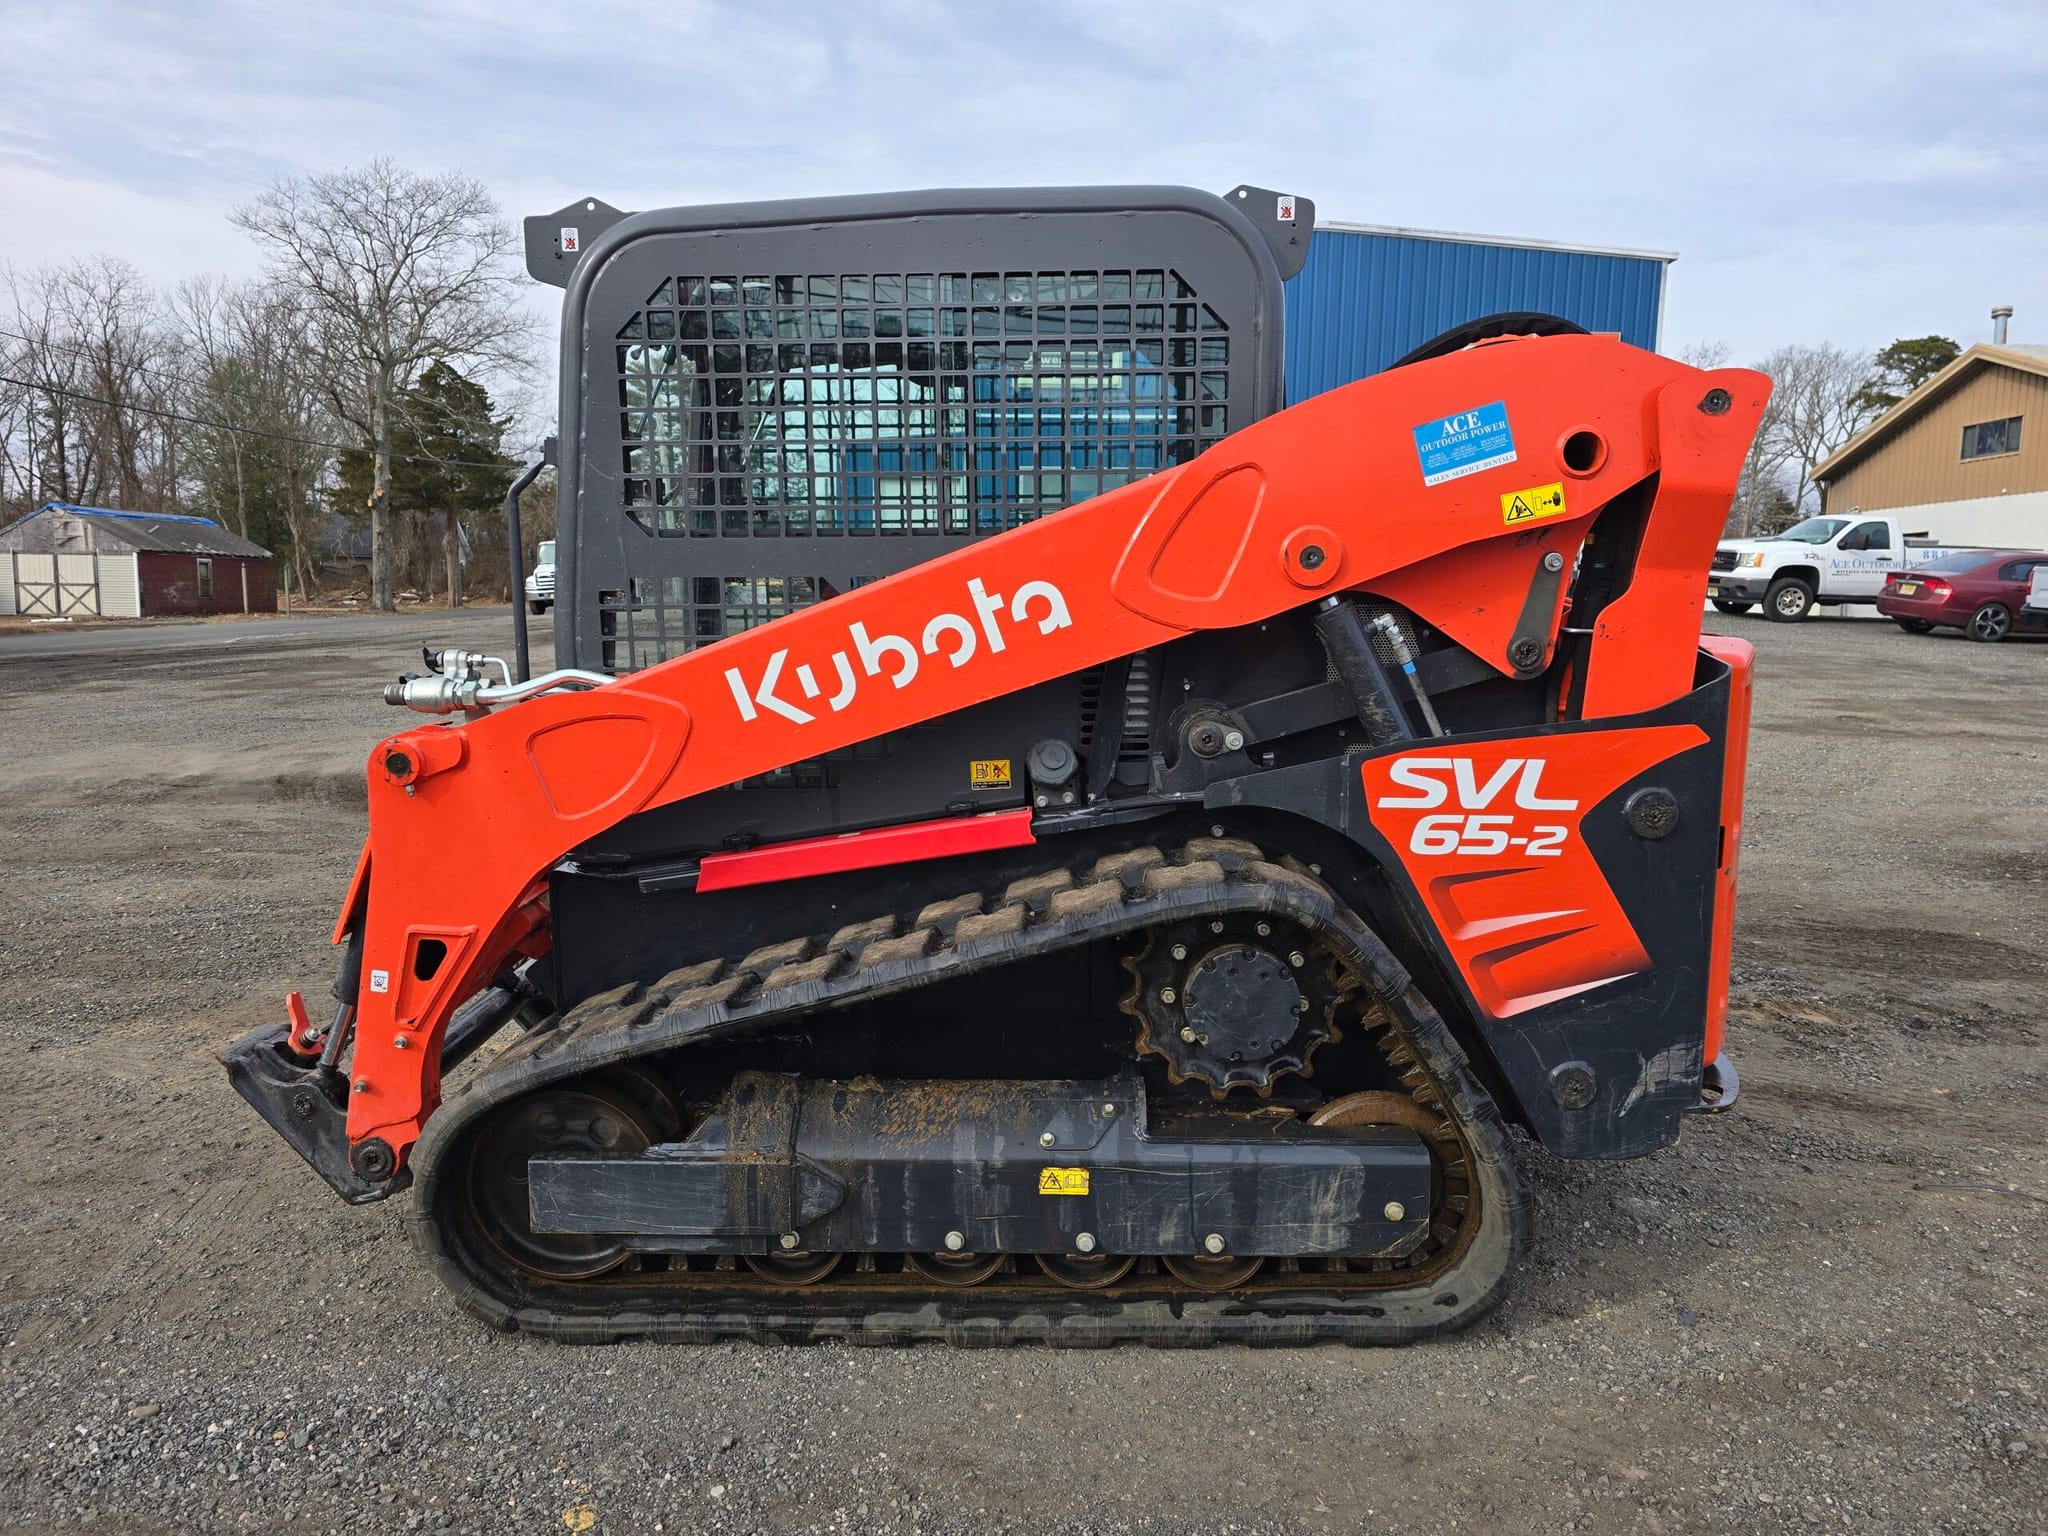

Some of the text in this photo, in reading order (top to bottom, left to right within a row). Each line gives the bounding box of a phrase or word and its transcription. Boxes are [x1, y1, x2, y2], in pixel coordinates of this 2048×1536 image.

[1421, 432, 1469, 452] OUTDOOR
[1470, 421, 1506, 438] POWER
[1441, 411, 1482, 437] ACE
[1428, 473, 1449, 484] SALES
[1452, 465, 1480, 477] SERVICE
[724, 577, 1072, 725] Kubota
[1377, 758, 1579, 810] SVL
[1409, 814, 1568, 856] 65-2
